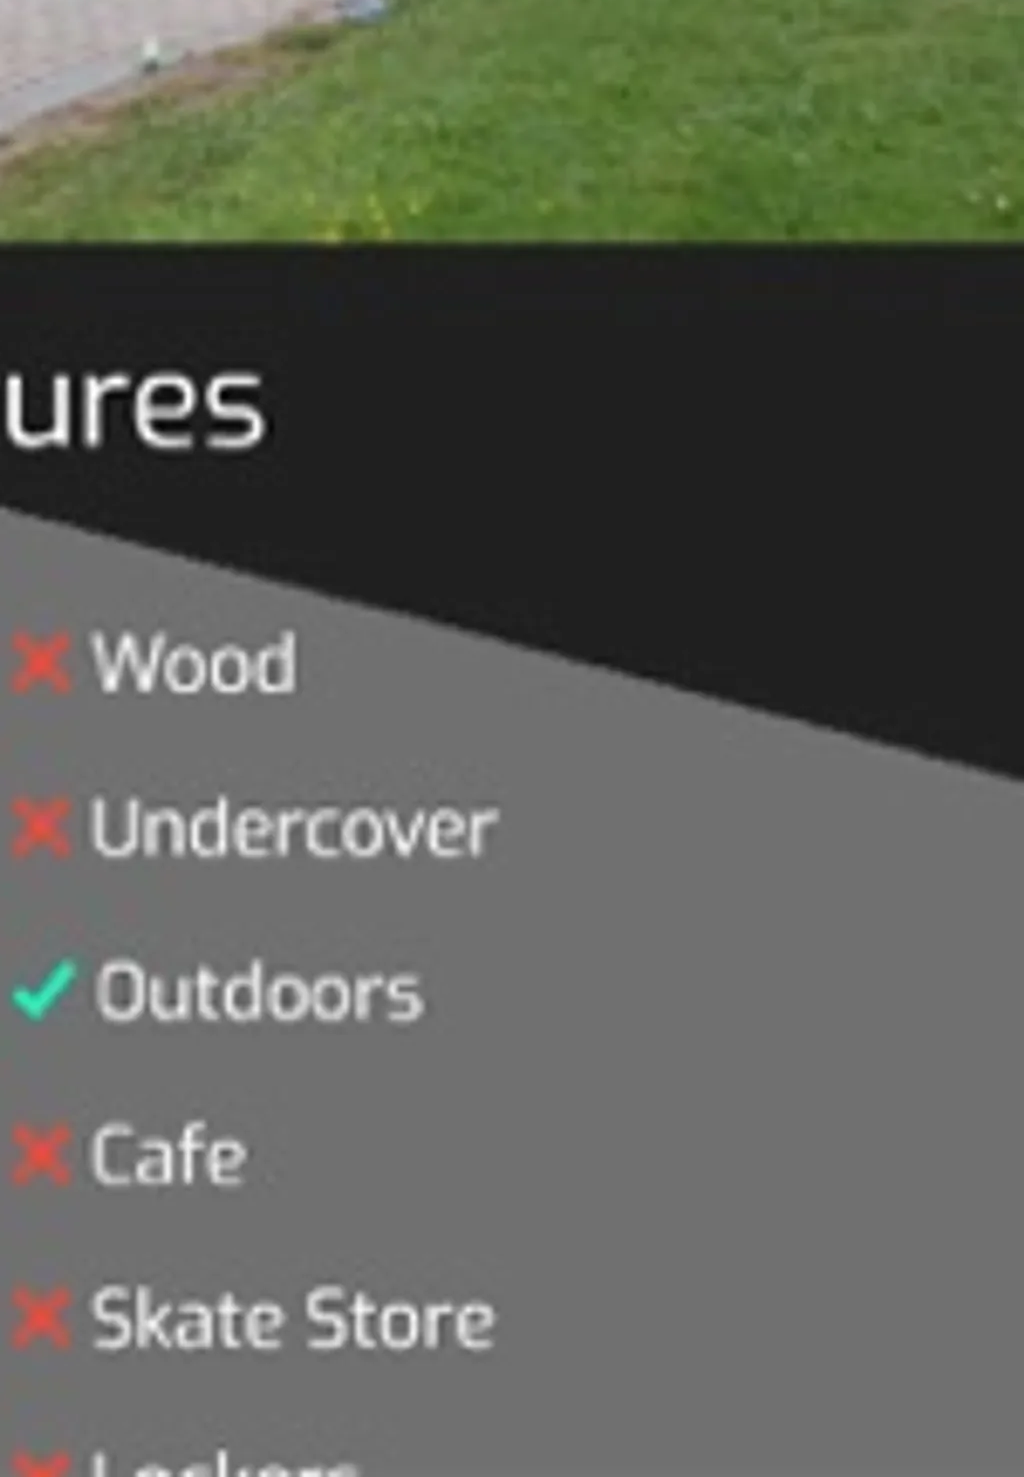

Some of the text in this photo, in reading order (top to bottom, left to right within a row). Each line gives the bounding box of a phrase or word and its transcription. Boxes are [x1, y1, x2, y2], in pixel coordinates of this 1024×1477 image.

[93, 632, 295, 694] Wood
[93, 796, 498, 858] Undercover
[99, 959, 423, 1021] Outdoors
[93, 1121, 246, 1185] Cafe
[93, 1286, 494, 1349] Skate Store
